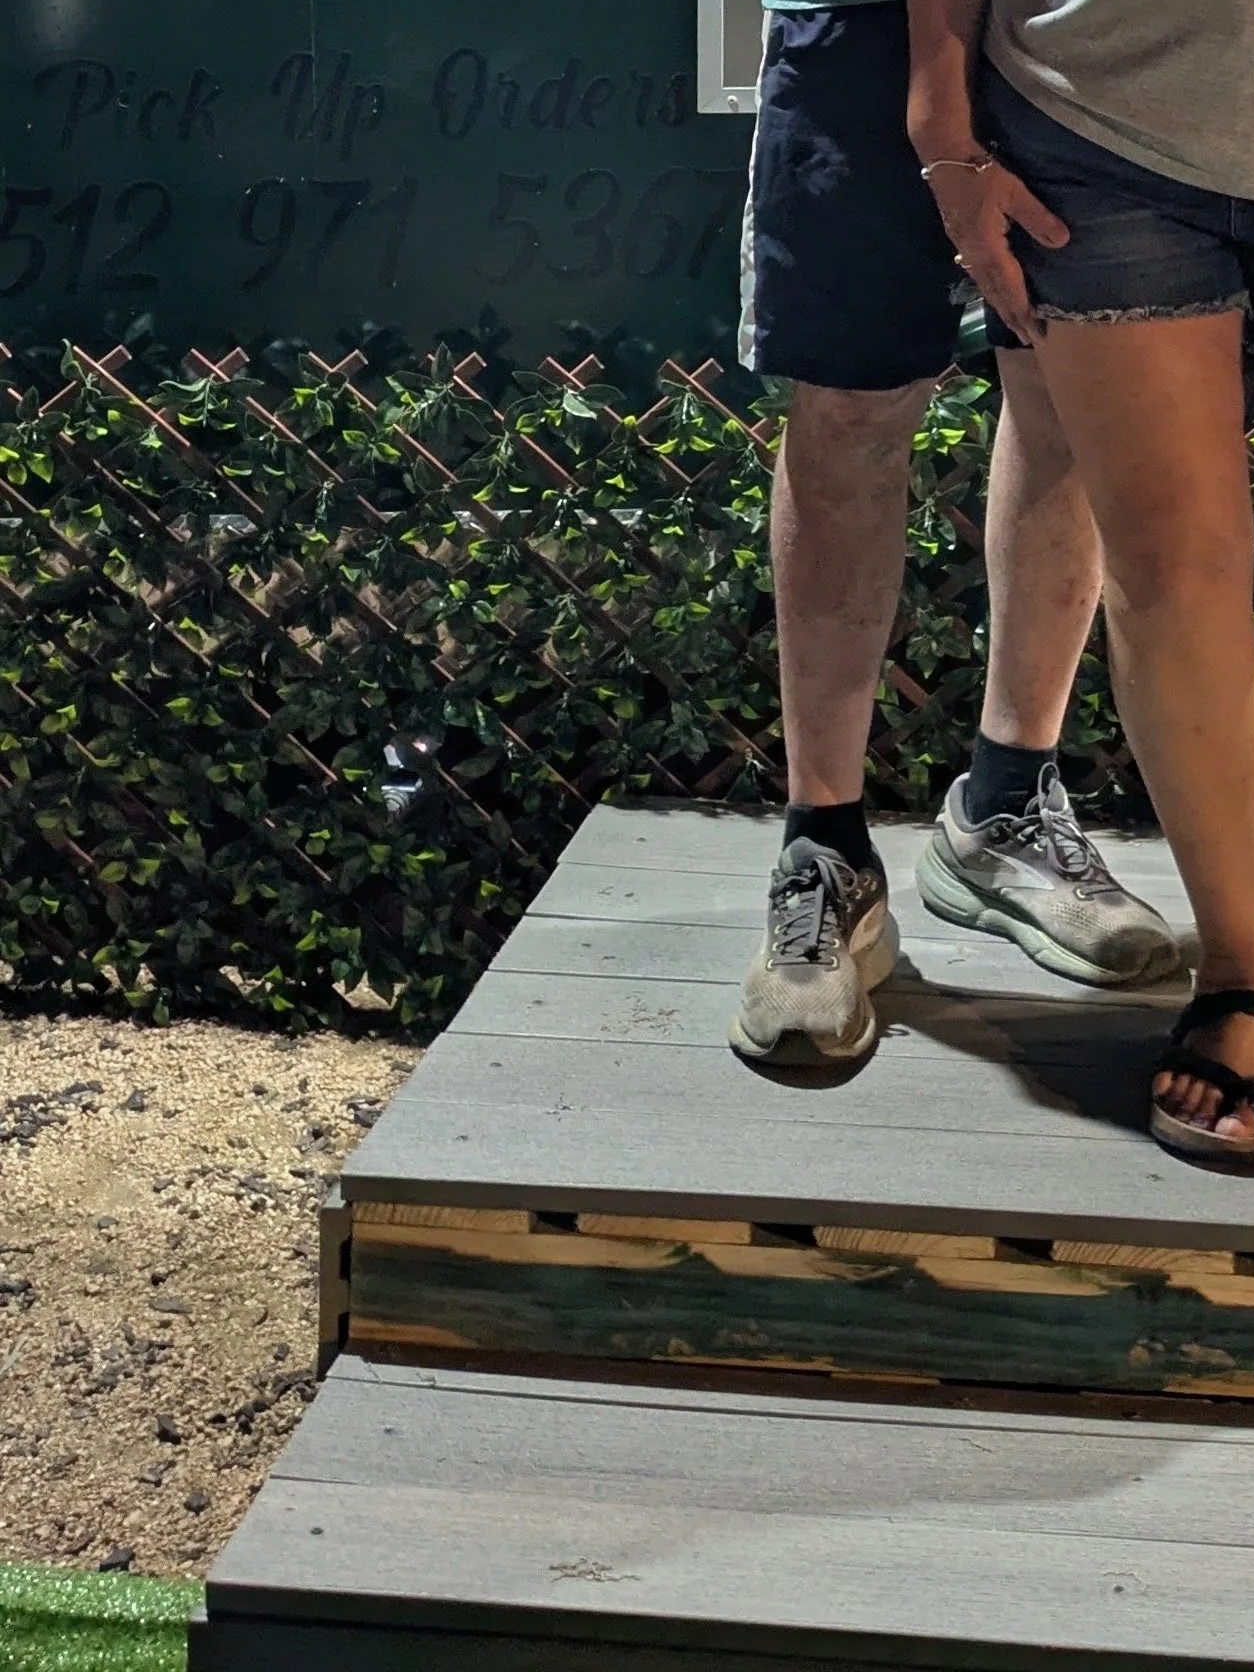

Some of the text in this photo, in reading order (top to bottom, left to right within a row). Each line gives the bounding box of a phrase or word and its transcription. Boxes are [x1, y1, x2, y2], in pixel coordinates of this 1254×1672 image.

[33, 46, 697, 162] Pick Up Orders
[0, 178, 174, 298] 512
[236, 174, 420, 292] 971
